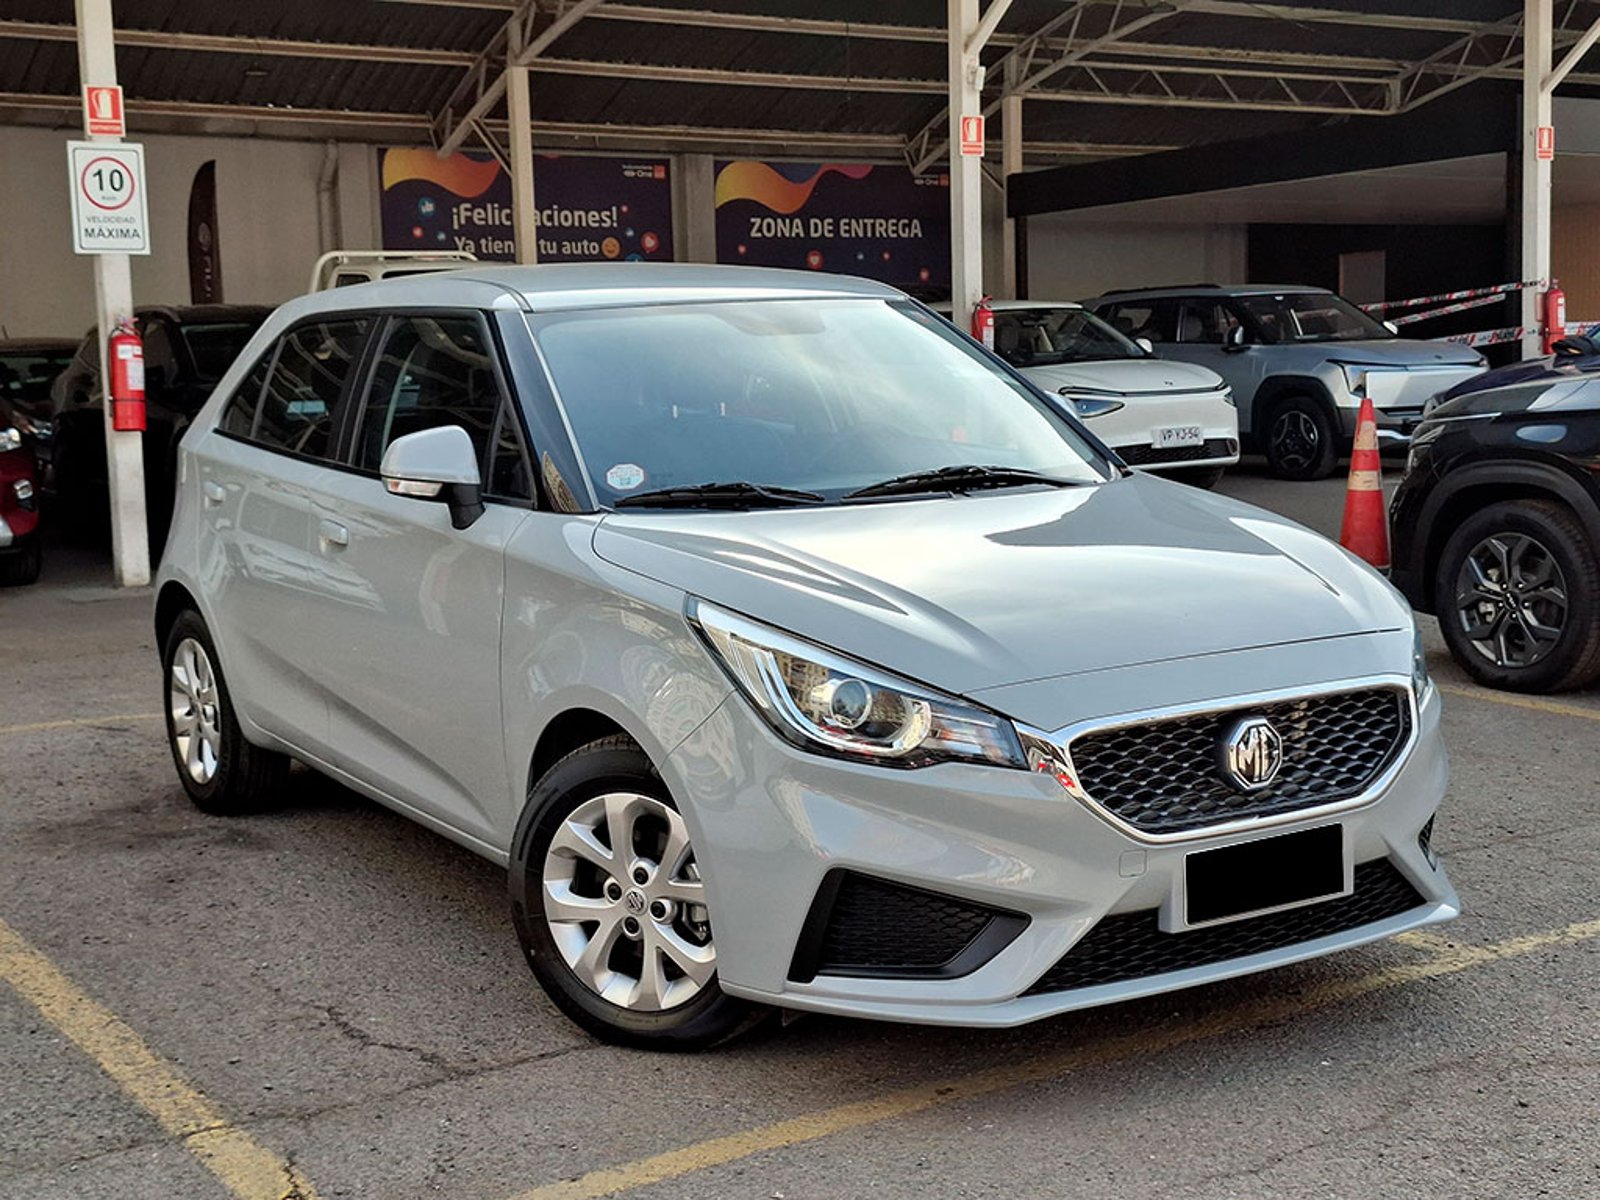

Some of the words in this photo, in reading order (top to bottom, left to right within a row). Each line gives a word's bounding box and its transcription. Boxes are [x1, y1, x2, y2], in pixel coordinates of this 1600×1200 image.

[93, 169, 124, 191] 10
[86, 216, 136, 224] VELOCIDAD
[452, 203, 618, 230] ¡Felicaciones!
[750, 218, 804, 238] ZONA
[810, 218, 834, 238] DE
[840, 218, 922, 238] ENTREGA
[454, 236, 476, 253] Ya
[539, 239, 557, 254] tu
[562, 240, 600, 254] auto
[1238, 726, 1279, 782] MG
